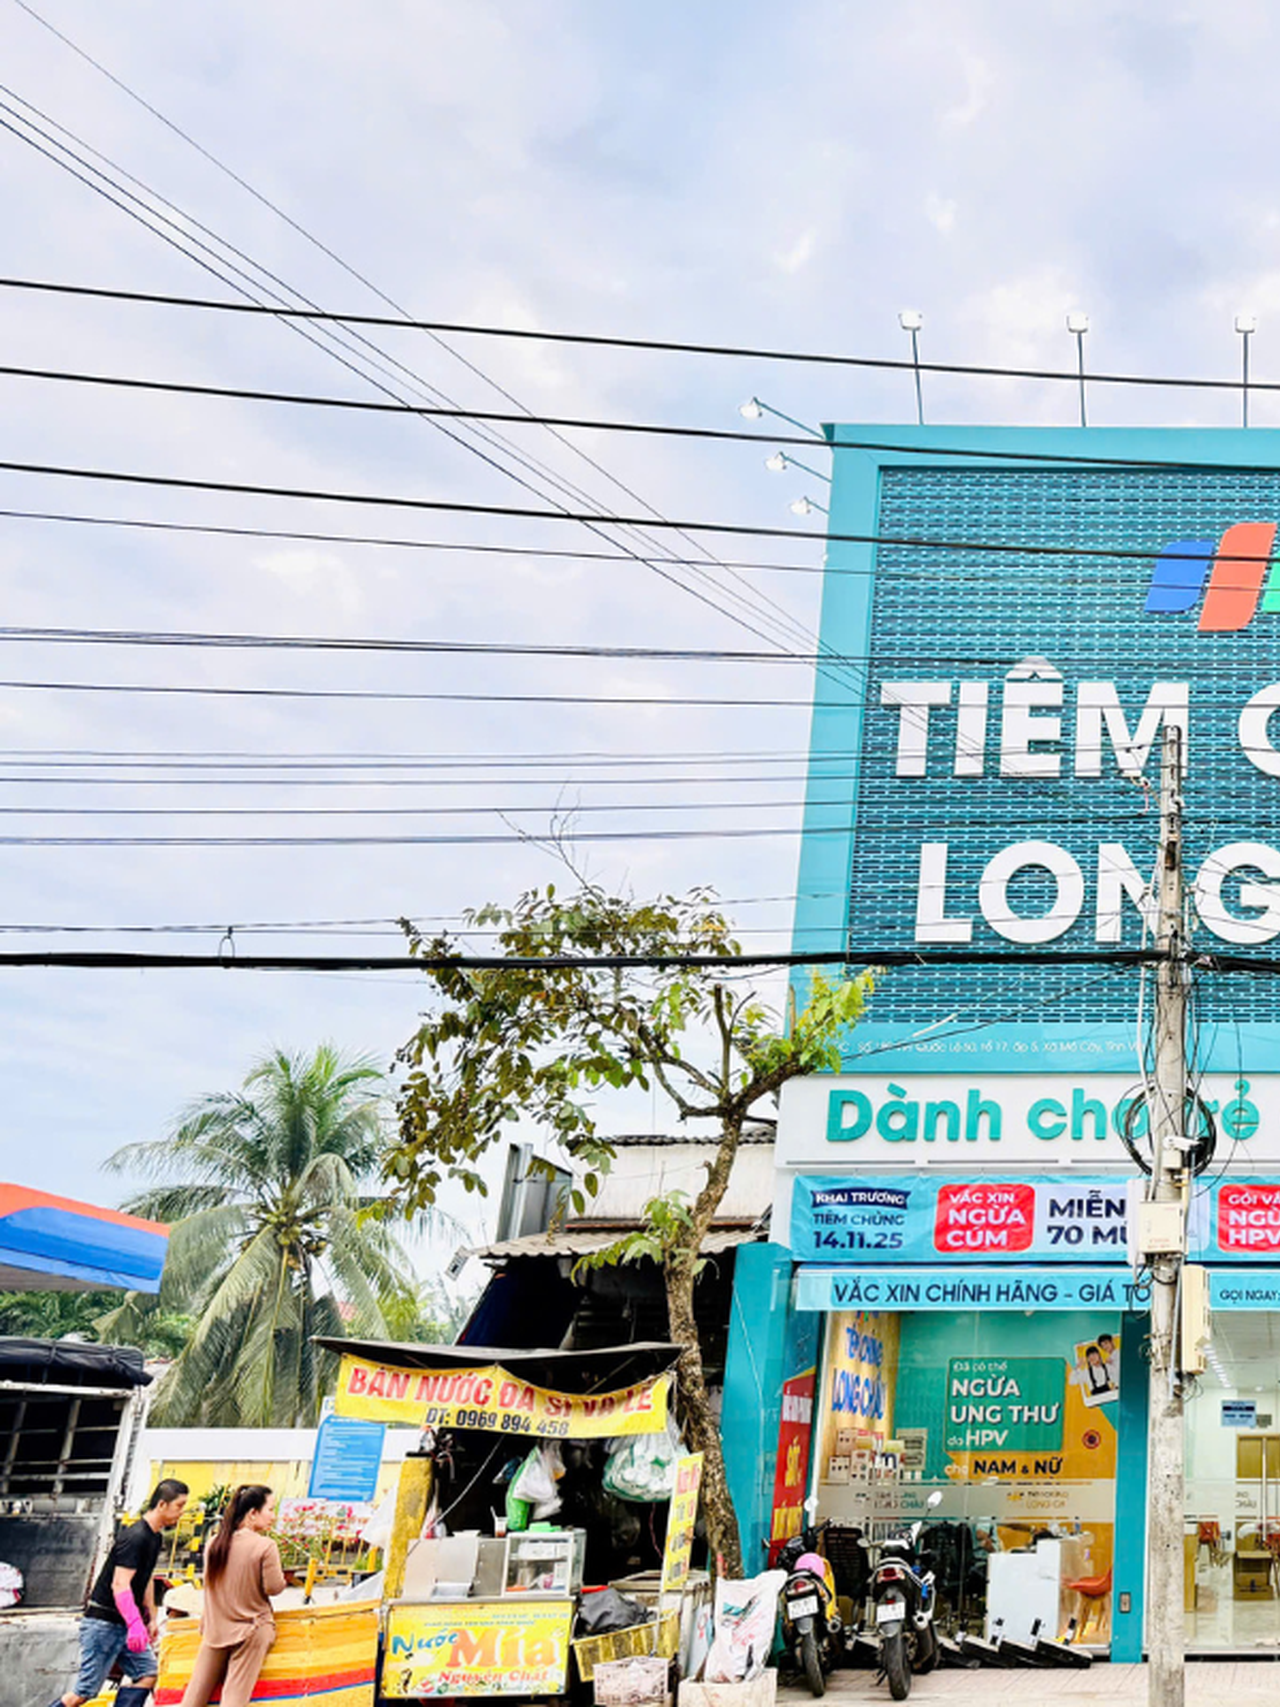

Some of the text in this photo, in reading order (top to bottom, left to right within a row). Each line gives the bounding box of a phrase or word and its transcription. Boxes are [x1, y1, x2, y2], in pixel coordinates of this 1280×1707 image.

[880, 656, 1189, 778] TIÊM
[826, 1082, 1002, 1142] Dành
[1027, 1088, 1150, 1141] cho
[815, 1191, 905, 1206] KHAI TRƯƠNG
[987, 1192, 1015, 1204] XIN
[1049, 1190, 1127, 1218] MIỄN
[1228, 1192, 1257, 1205] GÓI
[813, 1209, 905, 1227] TIÊM CHỦNG
[948, 1205, 1027, 1225] NGỪA
[813, 1231, 904, 1249] 14.11.25
[946, 1227, 1009, 1247] CÚM
[1047, 1226, 1084, 1245] 70
[833, 1276, 880, 1302] VẮC
[884, 1284, 920, 1302] XIN
[925, 1279, 992, 1302] CHÍNH
[995, 1280, 1058, 1302] HÃNG
[1078, 1278, 1115, 1302] GIÁ
[1219, 1289, 1243, 1304] GỌI
[1245, 1290, 1280, 1301] NGAY:
[972, 1361, 986, 1373] có
[348, 1365, 411, 1399] BÁN
[415, 1372, 493, 1405] NƯỚC
[952, 1374, 1021, 1397] NGỪA
[456, 1409, 498, 1428] 0969
[500, 1413, 532, 1433] 894
[537, 1420, 570, 1436] 458
[951, 1402, 1061, 1424] UNG THƯ
[966, 1429, 1009, 1447] HPV
[973, 1460, 1017, 1475] NAM
[1021, 1465, 1029, 1475] &
[1034, 1456, 1063, 1475] NỮ
[391, 1628, 558, 1668] Nước Mía
